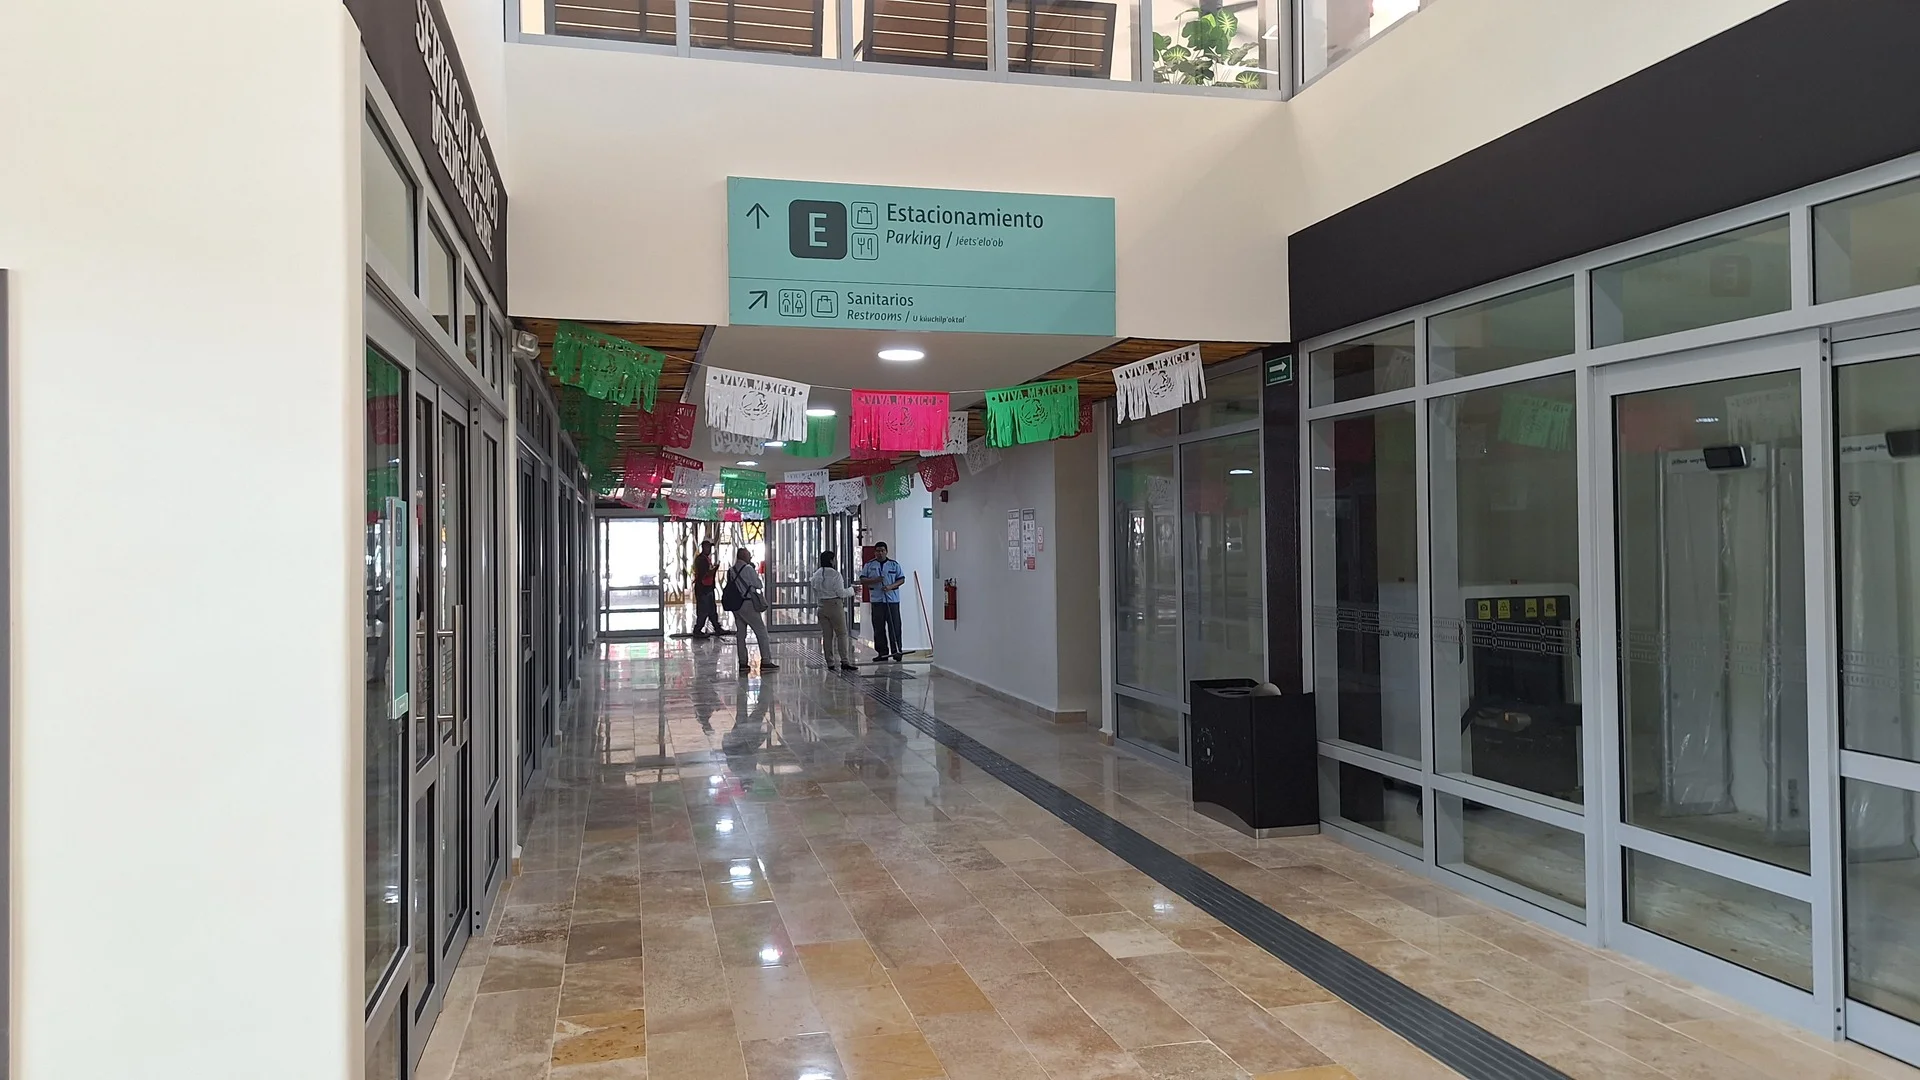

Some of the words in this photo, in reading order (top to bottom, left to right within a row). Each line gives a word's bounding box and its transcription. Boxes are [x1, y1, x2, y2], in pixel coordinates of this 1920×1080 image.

[430, 89, 474, 222] MEDICAL
[473, 192, 493, 262] CARE
[469, 127, 499, 231] MÉDICO
[887, 203, 1044, 229] Estacionamiento
[808, 212, 829, 247] E
[885, 229, 941, 250] Parking
[846, 291, 914, 307] Sanitarios
[846, 309, 902, 322] Restrooms
[1125, 364, 1149, 380] VIVA
[1152, 351, 1189, 371] MEXICO
[720, 373, 748, 388] VIVA
[753, 379, 794, 397] MEXICO
[998, 389, 1023, 403] VIVA
[1027, 384, 1065, 399] MEXICO
[864, 395, 890, 405] VIVA
[894, 395, 935, 406] MEXICO
